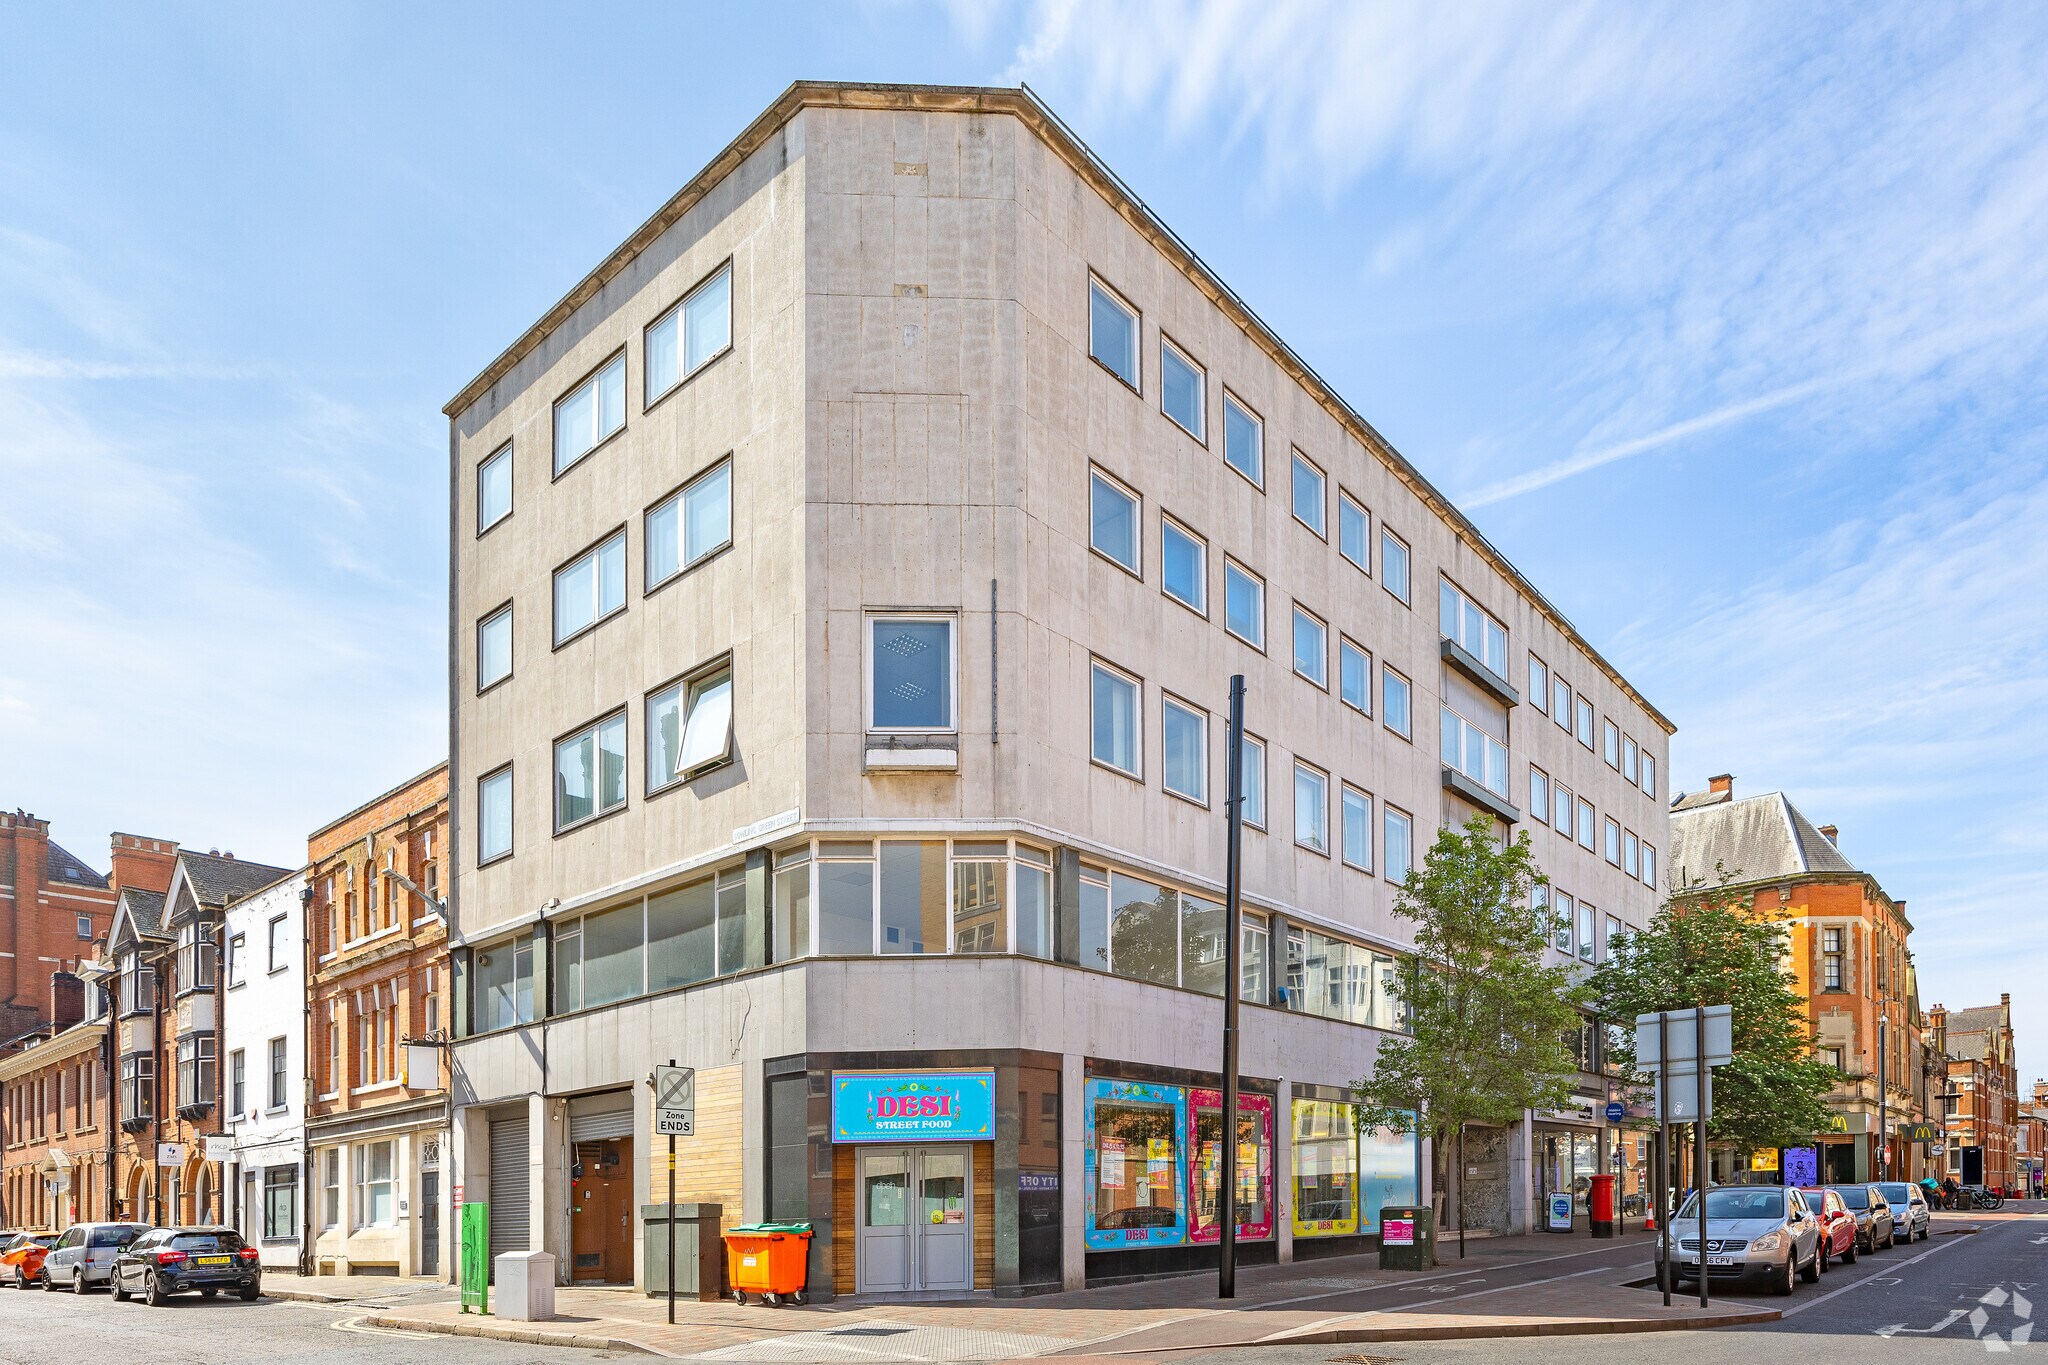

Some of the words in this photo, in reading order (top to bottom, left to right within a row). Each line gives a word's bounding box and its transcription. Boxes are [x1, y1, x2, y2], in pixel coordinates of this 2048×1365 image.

[758, 820, 775, 831] GREEN
[777, 812, 797, 826] STREET
[876, 1095, 952, 1118] DESI
[666, 1111, 685, 1120] Zone
[660, 1121, 690, 1131] ENDS
[875, 1120, 919, 1129] STREET
[921, 1120, 952, 1129] FOOD
[877, 1182, 896, 1190] open
[1318, 1220, 1333, 1230] DESI
[1125, 1229, 1149, 1240] DESI
